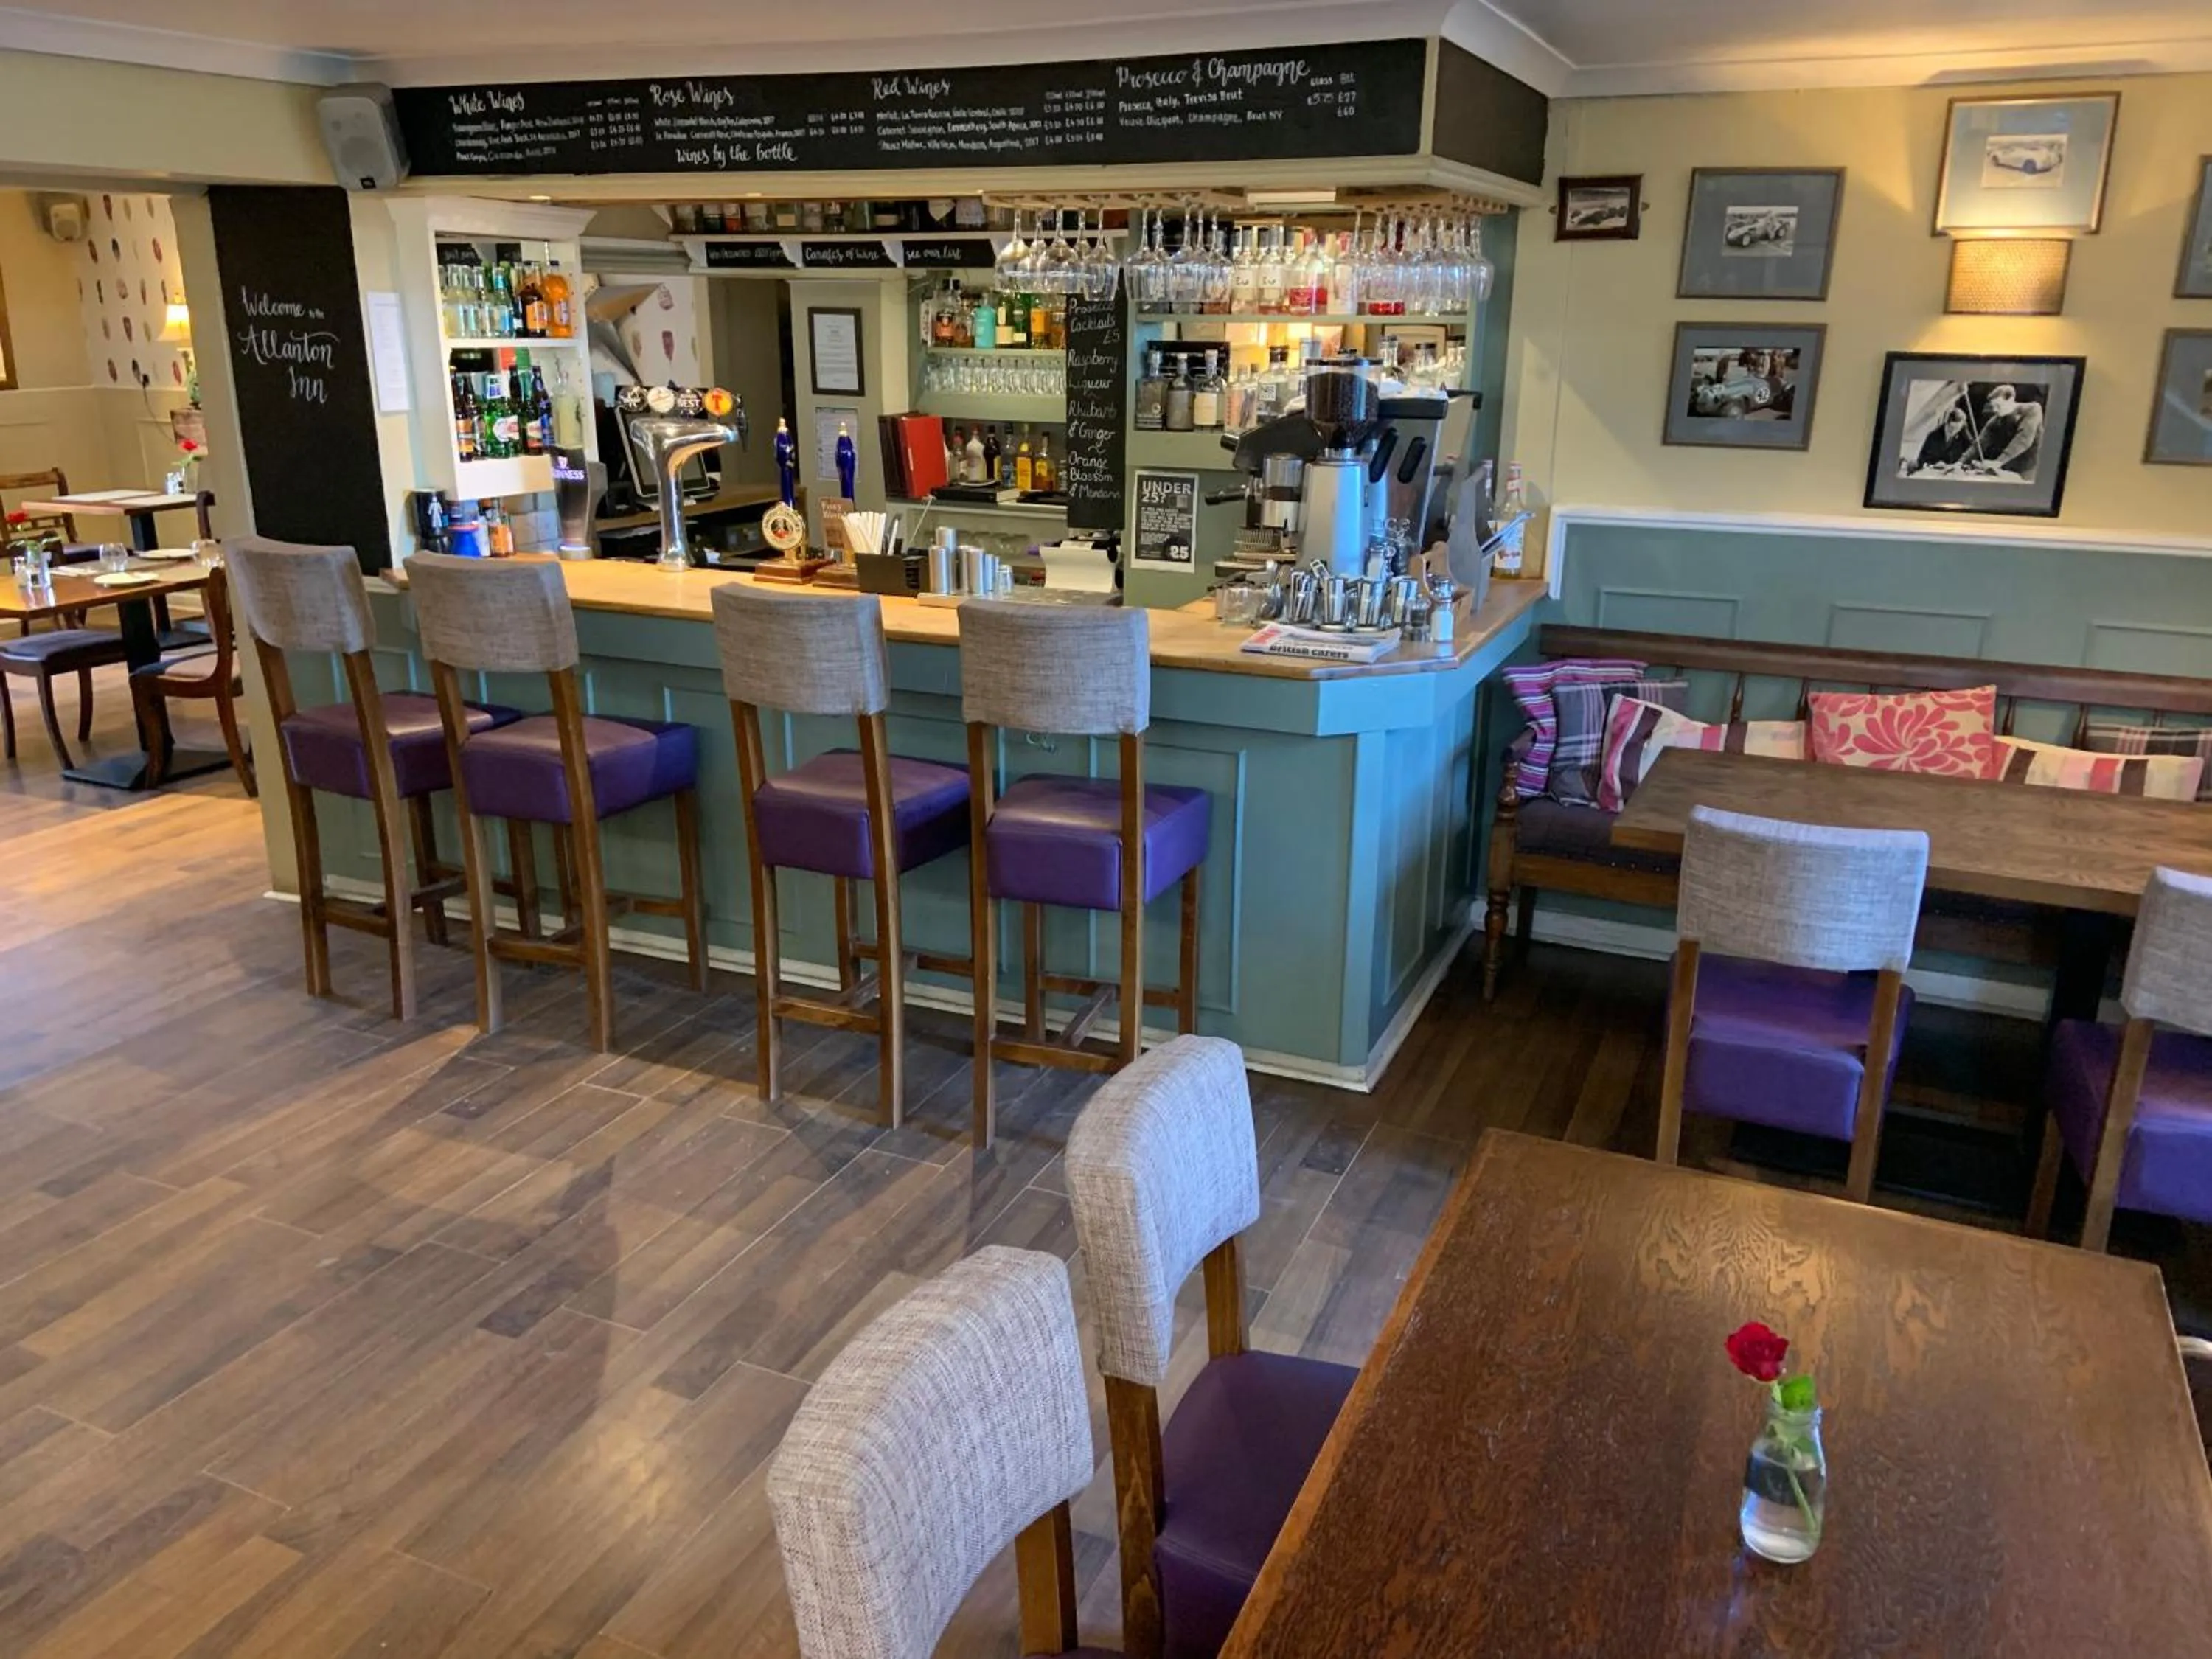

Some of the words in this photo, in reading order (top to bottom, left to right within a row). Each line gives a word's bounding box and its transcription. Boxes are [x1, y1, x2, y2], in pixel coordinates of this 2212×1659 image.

[1116, 66, 1187, 88] Prosecco
[1208, 58, 1310, 86] Champagne
[649, 83, 686, 107] Rose
[685, 81, 734, 111] Wines
[870, 77, 901, 100] Red
[902, 76, 950, 100] Wines
[448, 92, 486, 116] White
[487, 91, 525, 113] Wines
[712, 144, 726, 169] by
[729, 144, 751, 161] the
[756, 141, 799, 162] bottle
[240, 285, 305, 318] Welcome
[1068, 297, 1116, 316] Prosecco
[1070, 313, 1116, 333] Cocktails
[237, 324, 341, 370] Allanton
[1102, 328, 1121, 344] £5
[1068, 347, 1119, 375] Raspberry
[288, 365, 329, 404] Inn
[712, 394, 723, 410] T
[1068, 400, 1118, 419] Rhubarb
[1068, 451, 1109, 474] Orange
[1070, 467, 1114, 483] Blossom
[1141, 492, 1166, 504] 25?
[1142, 479, 1192, 495] UNDER
